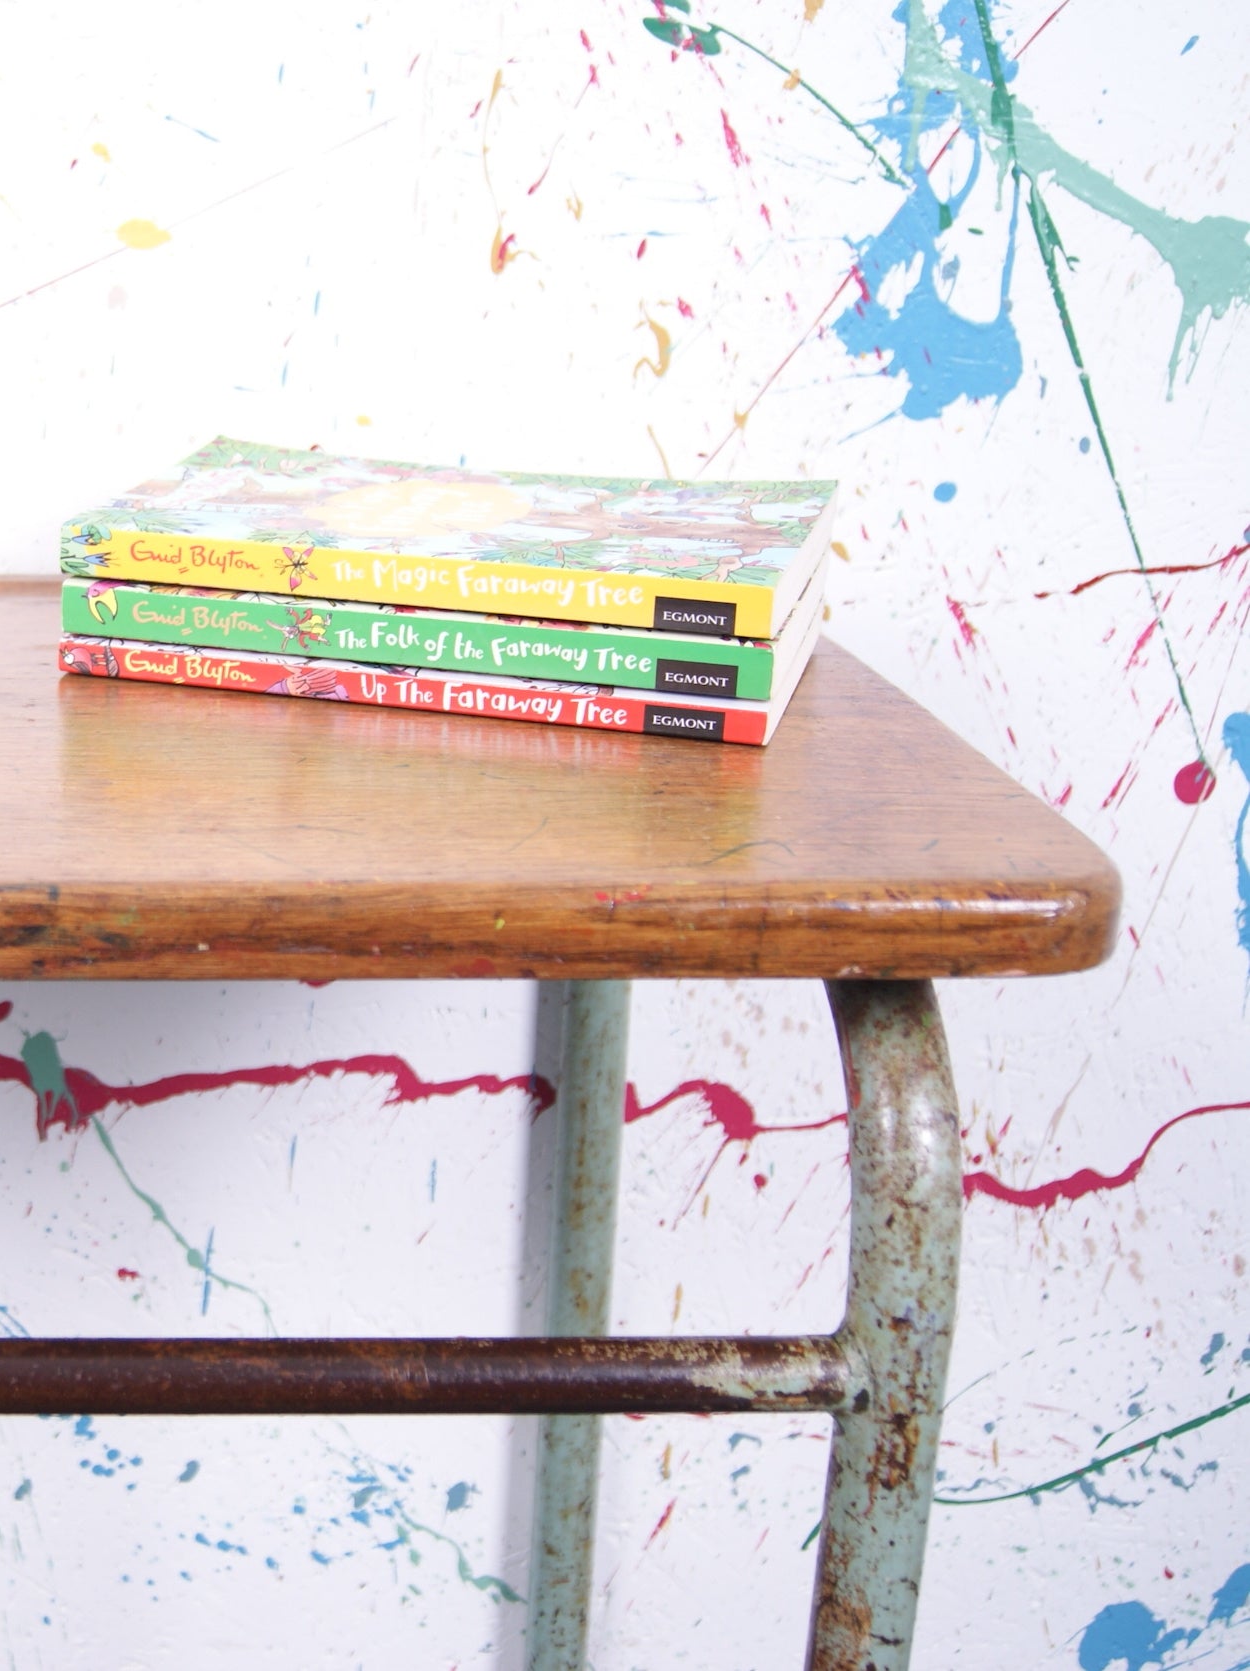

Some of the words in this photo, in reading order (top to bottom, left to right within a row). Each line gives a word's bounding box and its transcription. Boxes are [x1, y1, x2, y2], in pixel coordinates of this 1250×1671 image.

[130, 540, 184, 569] Enid
[190, 546, 260, 577] Blyton
[333, 560, 366, 581] The
[372, 560, 450, 592] Magic
[457, 564, 575, 606] Faraway
[580, 578, 644, 608] Tree
[132, 601, 185, 627] Enid
[193, 608, 263, 636] Blyton
[662, 610, 728, 627] EGMONT
[335, 628, 367, 649] The
[370, 621, 420, 649] Folk
[424, 632, 447, 662] of
[453, 631, 484, 660] the
[491, 635, 588, 672] Faraway
[593, 648, 652, 673] Tree
[124, 649, 178, 676] Enid
[184, 656, 256, 684] Blyton
[664, 671, 729, 688] EGMONT
[360, 674, 387, 703] Up
[394, 682, 434, 705] The
[442, 681, 563, 722] Faraway
[570, 697, 628, 726] Tree
[652, 713, 717, 731] EGMONT
